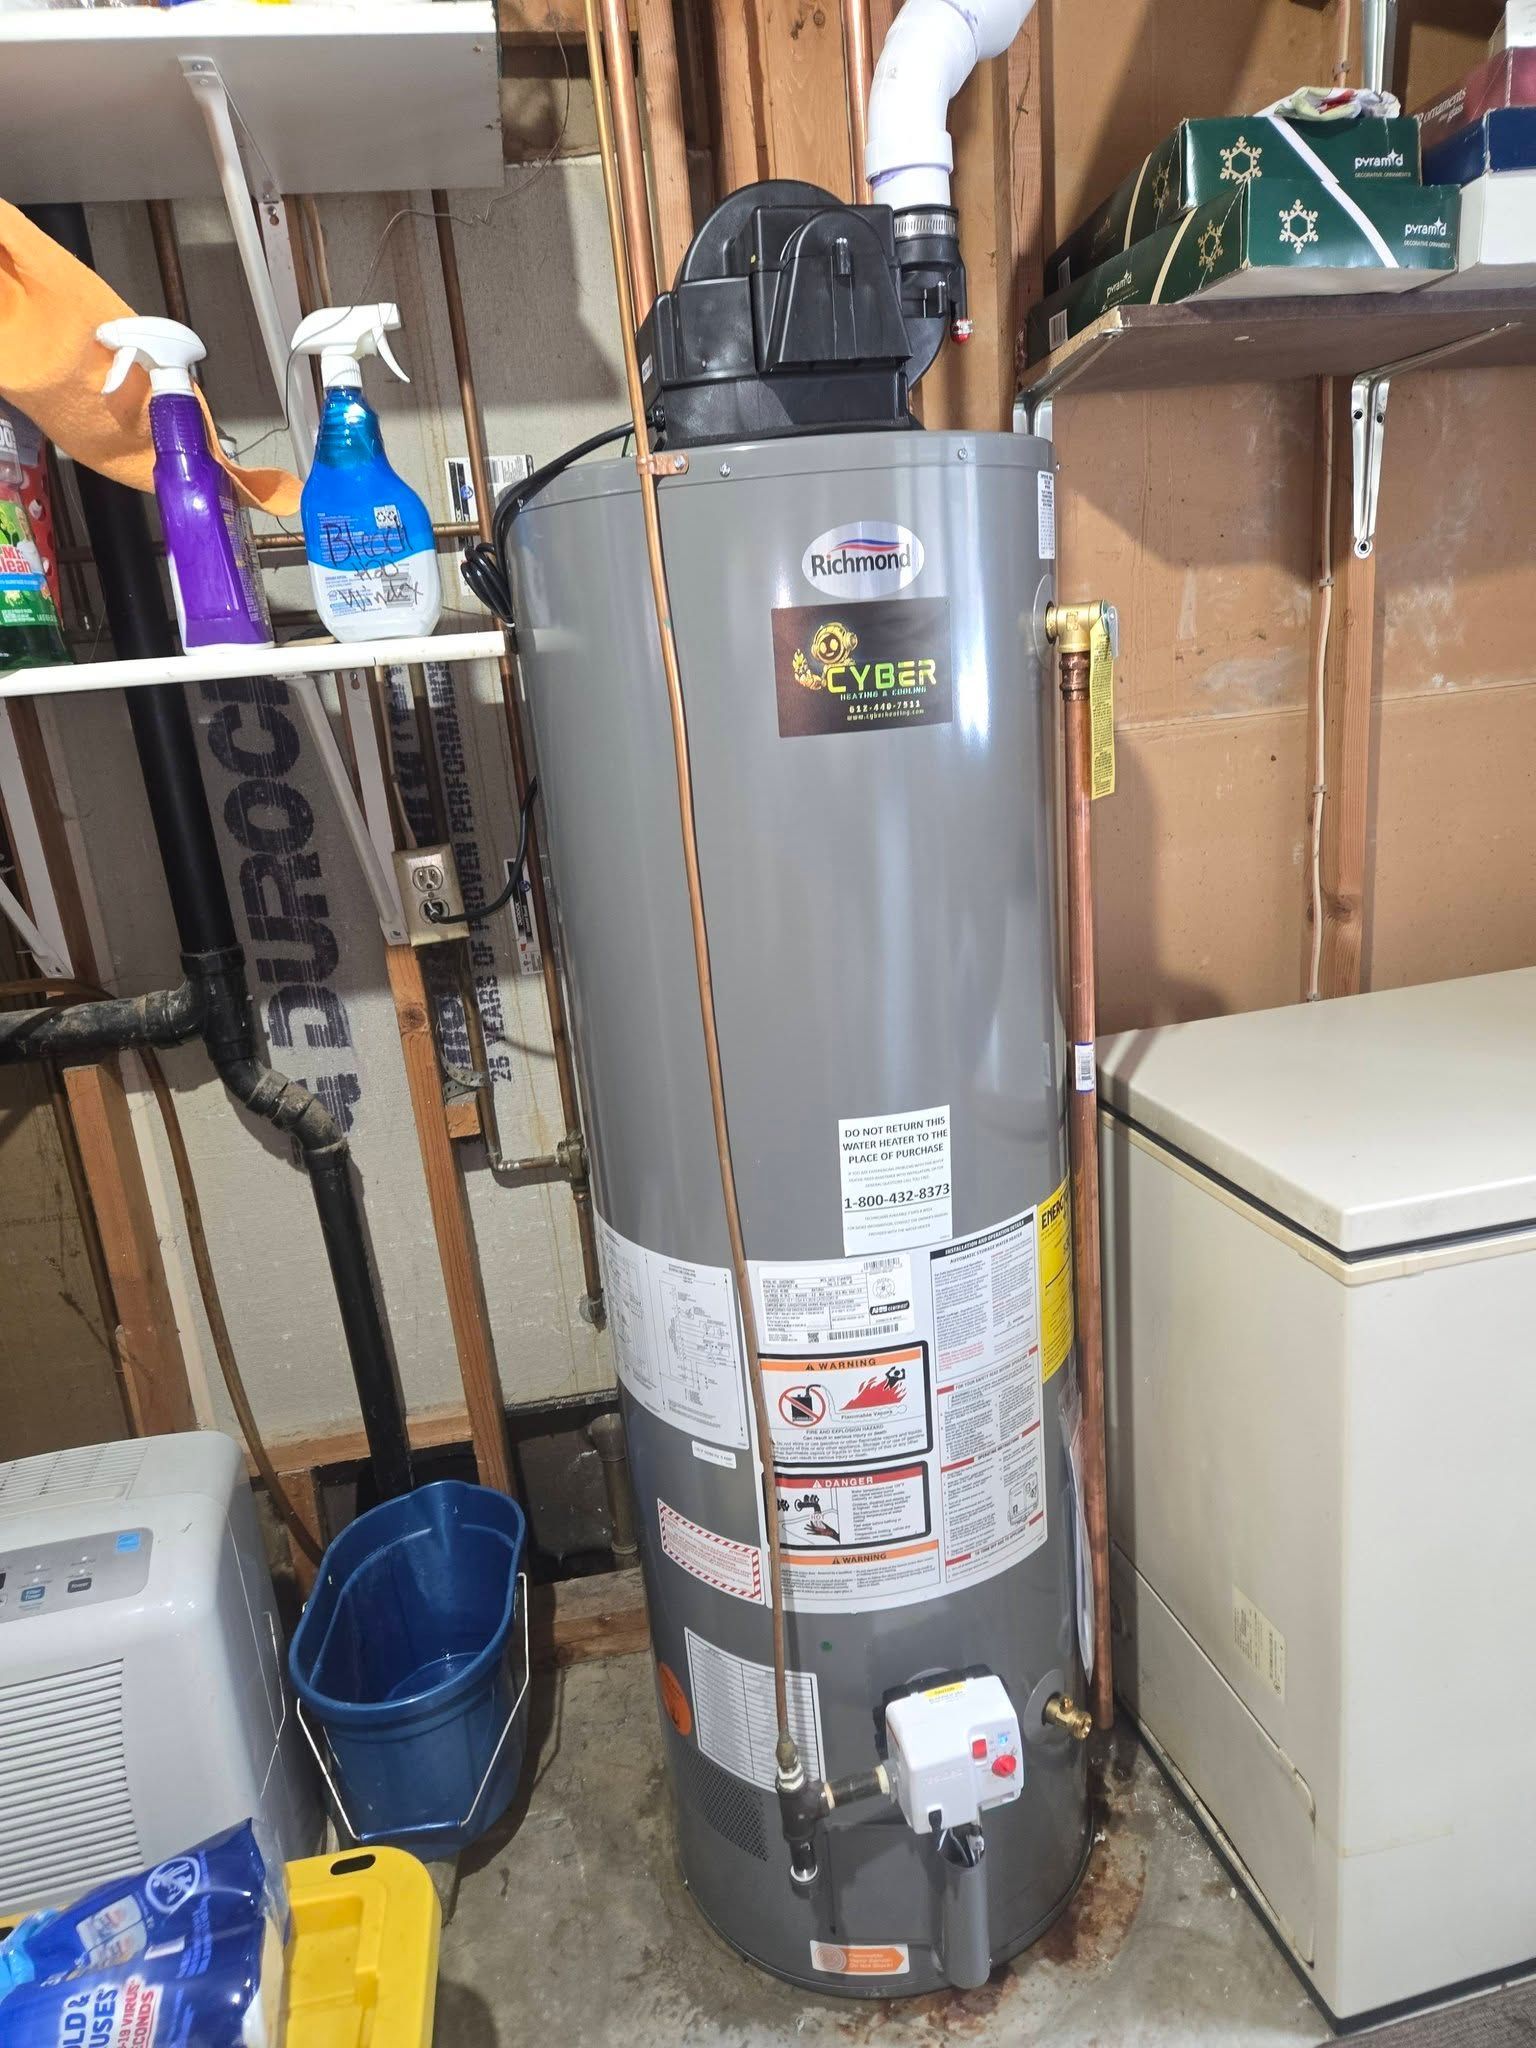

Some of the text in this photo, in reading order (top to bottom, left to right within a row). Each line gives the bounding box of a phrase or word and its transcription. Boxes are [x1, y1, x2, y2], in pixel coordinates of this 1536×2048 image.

[0, 557, 32, 573] lean
[811, 543, 911, 577] Richmond
[826, 659, 937, 693] CYBER
[840, 690, 879, 701] HEATING
[892, 686, 927, 696] COOLING
[201, 677, 352, 1048] DUROC
[471, 940, 495, 967] OF
[476, 975, 506, 1047] YEARS
[488, 1055, 513, 1083] 25
[842, 1129, 948, 1151] WATER HEATER TO THE
[844, 1116, 946, 1138] DO NOT RETURN THIS
[848, 1143, 944, 1164] PLACE OF PURCHASE
[844, 1183, 950, 1209] 1-800-432-8373
[819, 1358, 877, 1370] WARNING
[825, 1476, 874, 1488] DANGER
[842, 1553, 887, 1564] WARNING
[63, 2013, 87, 2048] LD
[132, 1991, 154, 2048] CONDS
